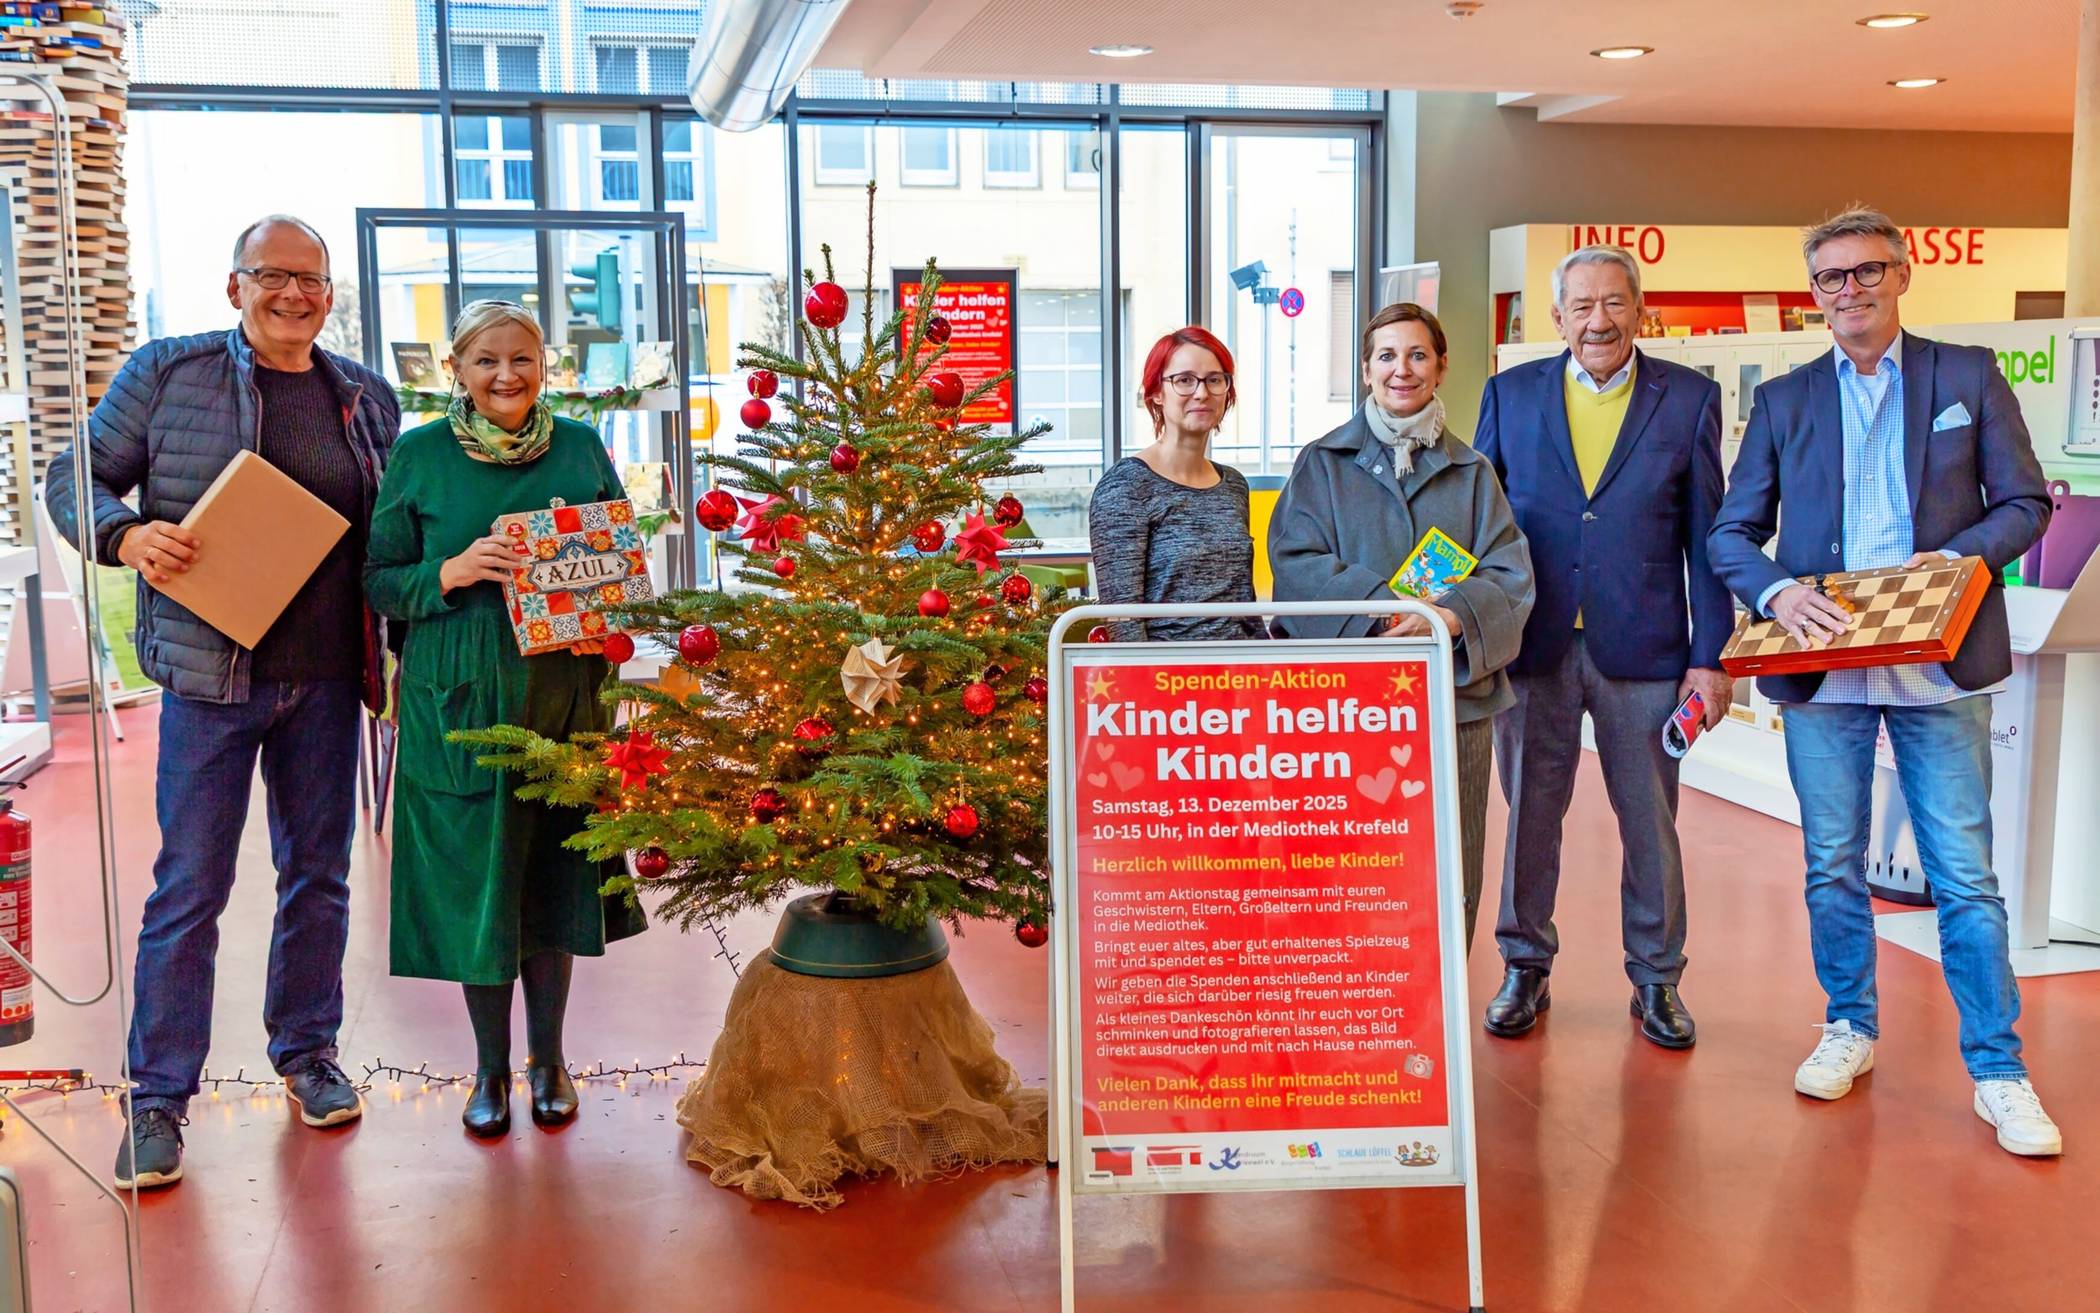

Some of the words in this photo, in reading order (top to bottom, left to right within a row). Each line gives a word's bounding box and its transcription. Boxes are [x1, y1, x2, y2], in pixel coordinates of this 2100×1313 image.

[1574, 226, 1665, 265] INFO
[1904, 228, 1985, 265] ASSE
[904, 294, 955, 307] Kder
[958, 293, 1006, 307] helfen
[936, 308, 986, 321] indern
[548, 558, 614, 583] AZUL
[1154, 668, 1346, 693] Spenden-Aktion
[1086, 700, 1250, 736] Kinder
[1266, 697, 1417, 734] helfen
[1156, 743, 1351, 781] Kindern
[1092, 799, 1174, 816] Samstag,
[1178, 796, 1203, 813] 13.
[1207, 795, 1300, 812] Dezember
[1303, 794, 1348, 811] 2025
[1092, 823, 1142, 839] 10-15
[1146, 822, 1183, 842] Uhr,
[1187, 822, 1204, 838] in
[1208, 821, 1239, 838] der
[1243, 819, 1340, 837] Mediothek
[1343, 818, 1408, 835] Krefeld
[1093, 855, 1167, 872] Herzlich
[1171, 854, 1287, 873] willkommen,
[1290, 852, 1335, 869] liebe
[1339, 851, 1403, 868] Kinder!
[1093, 890, 1141, 901] Kommt
[1144, 890, 1165, 901] am
[1168, 887, 1240, 902] Aktionstag
[1242, 885, 1319, 901] gemeinsam
[1321, 884, 1344, 897] mit
[1346, 886, 1385, 896] euren
[1093, 903, 1188, 917] Geschwistern,
[1191, 902, 1236, 916] Eltern,
[1238, 900, 1312, 914] Großeltern
[1315, 899, 1341, 913] und
[1344, 898, 1408, 912] Freunden
[1093, 920, 1106, 932] in
[1109, 919, 1130, 932] die
[1133, 917, 1208, 931] Mediothek.
[1094, 940, 1136, 955] Bringt
[1138, 941, 1169, 952] euer
[1172, 938, 1209, 953] altes,
[1211, 937, 1243, 951] aber
[1244, 938, 1268, 953] gut
[1270, 935, 1342, 949] erhaltenes
[1345, 934, 1410, 950] Spielzeug
[1094, 955, 1117, 968] mit
[1120, 954, 1147, 968] und
[1148, 953, 1205, 970] spendet
[1207, 955, 1224, 966] es
[1238, 951, 1271, 965] bitte
[1273, 950, 1353, 966] unverpackt.
[1094, 976, 1117, 989] Wir
[1120, 975, 1163, 991] geben
[1165, 974, 1187, 988] die
[1189, 973, 1250, 989] Spenden
[1252, 970, 1343, 986] anschließend
[1345, 972, 1362, 984] an
[1365, 969, 1410, 983] Kinder
[1095, 991, 1140, 1006] weiter,
[1143, 990, 1164, 1004] die
[1167, 989, 1195, 1003] sich
[1197, 988, 1252, 1002] darüber
[1255, 987, 1292, 1003] riesig
[1294, 986, 1339, 1000] freuen
[1341, 985, 1395, 999] werden.
[1095, 1012, 1116, 1025] Als
[1119, 1011, 1167, 1025] kleines
[1167, 1009, 1252, 1024] Dankeschön
[1255, 1008, 1295, 1022] könnt
[1297, 1007, 1316, 1021] ihr
[1319, 1007, 1352, 1020] euch
[1355, 1008, 1378, 1019] vor
[1381, 1006, 1404, 1018] Ort
[1095, 1027, 1169, 1041] schminken
[1171, 1025, 1199, 1039] und
[1200, 1023, 1291, 1041] fotografieren
[1293, 1023, 1340, 1037] lassen,
[1343, 1022, 1367, 1035] das
[1370, 1020, 1397, 1034] Bild
[1096, 1043, 1136, 1057] direkt
[1138, 1041, 1218, 1056] ausdrucken
[1220, 1040, 1247, 1054] und
[1250, 1039, 1274, 1053] mit
[1276, 1038, 1309, 1053] nach
[1312, 1039, 1355, 1051] Hause
[1358, 1037, 1416, 1050] nehmen.
[1097, 1076, 1150, 1091] Vielen
[1155, 1074, 1205, 1092] Dank,
[1207, 1073, 1247, 1090] dass
[1250, 1072, 1275, 1088] ihr
[1278, 1070, 1361, 1088] mitmacht
[1365, 1069, 1398, 1085] und
[1095, 1096, 1169, 1113] anderen
[1172, 1093, 1240, 1110] Kindern
[1244, 1092, 1282, 1108] eine
[1285, 1090, 1345, 1107] Freude
[1348, 1088, 1421, 1105] schenkt!
